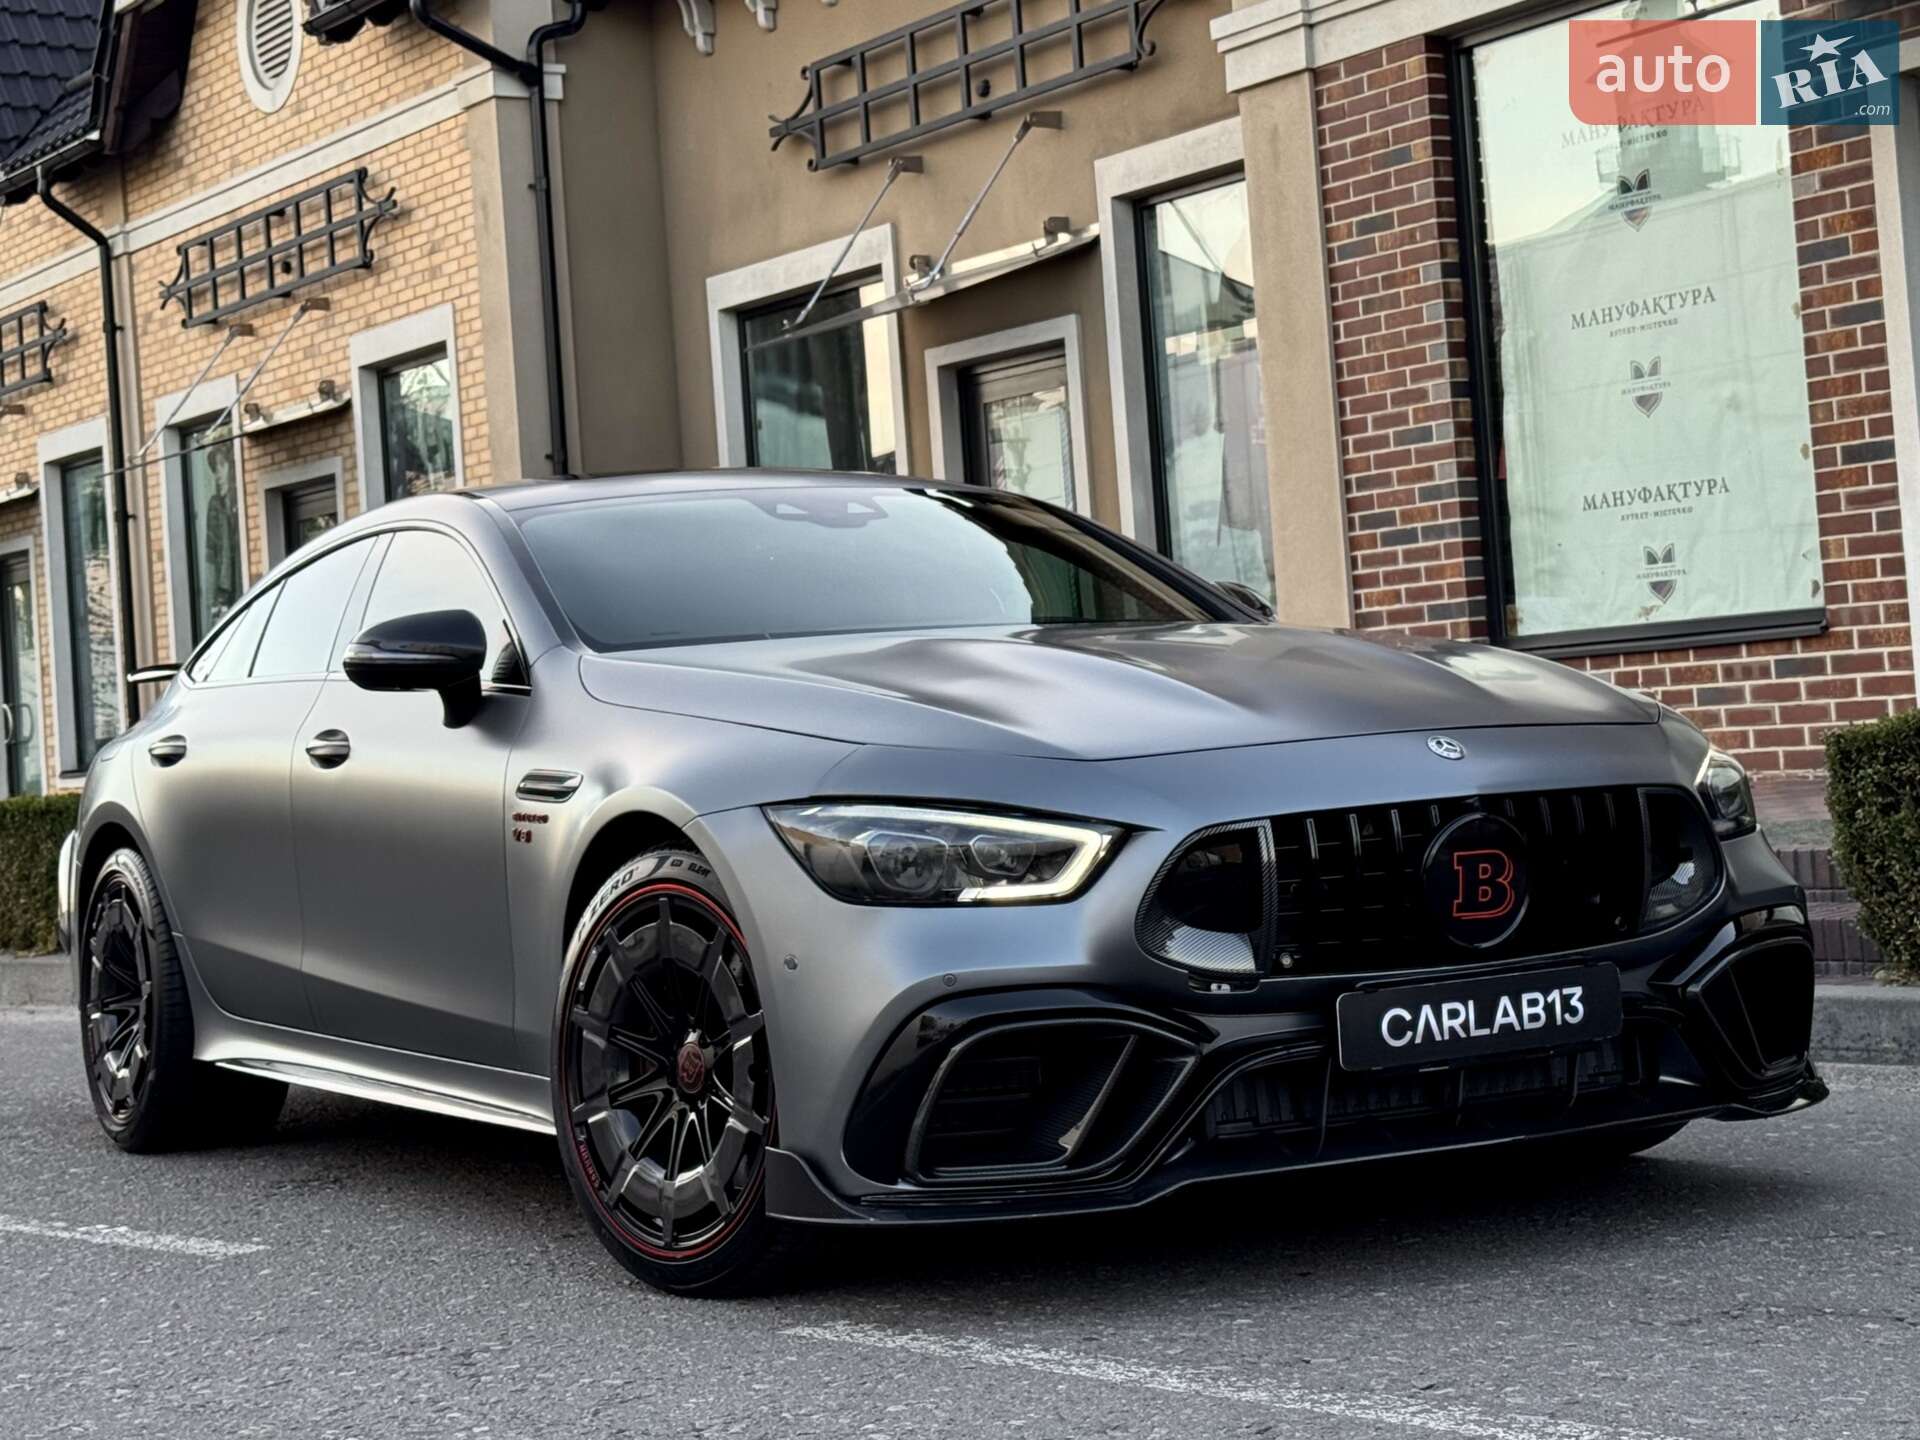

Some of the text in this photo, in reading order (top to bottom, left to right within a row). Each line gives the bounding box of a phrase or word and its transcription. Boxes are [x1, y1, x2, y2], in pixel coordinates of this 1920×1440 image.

[1570, 285, 1717, 331] МАНУФАКТУРА
[1582, 476, 1731, 513] МАНУФАКТУРА
[1452, 849, 1515, 920] B
[1381, 985, 1585, 1048] CARLAB13
